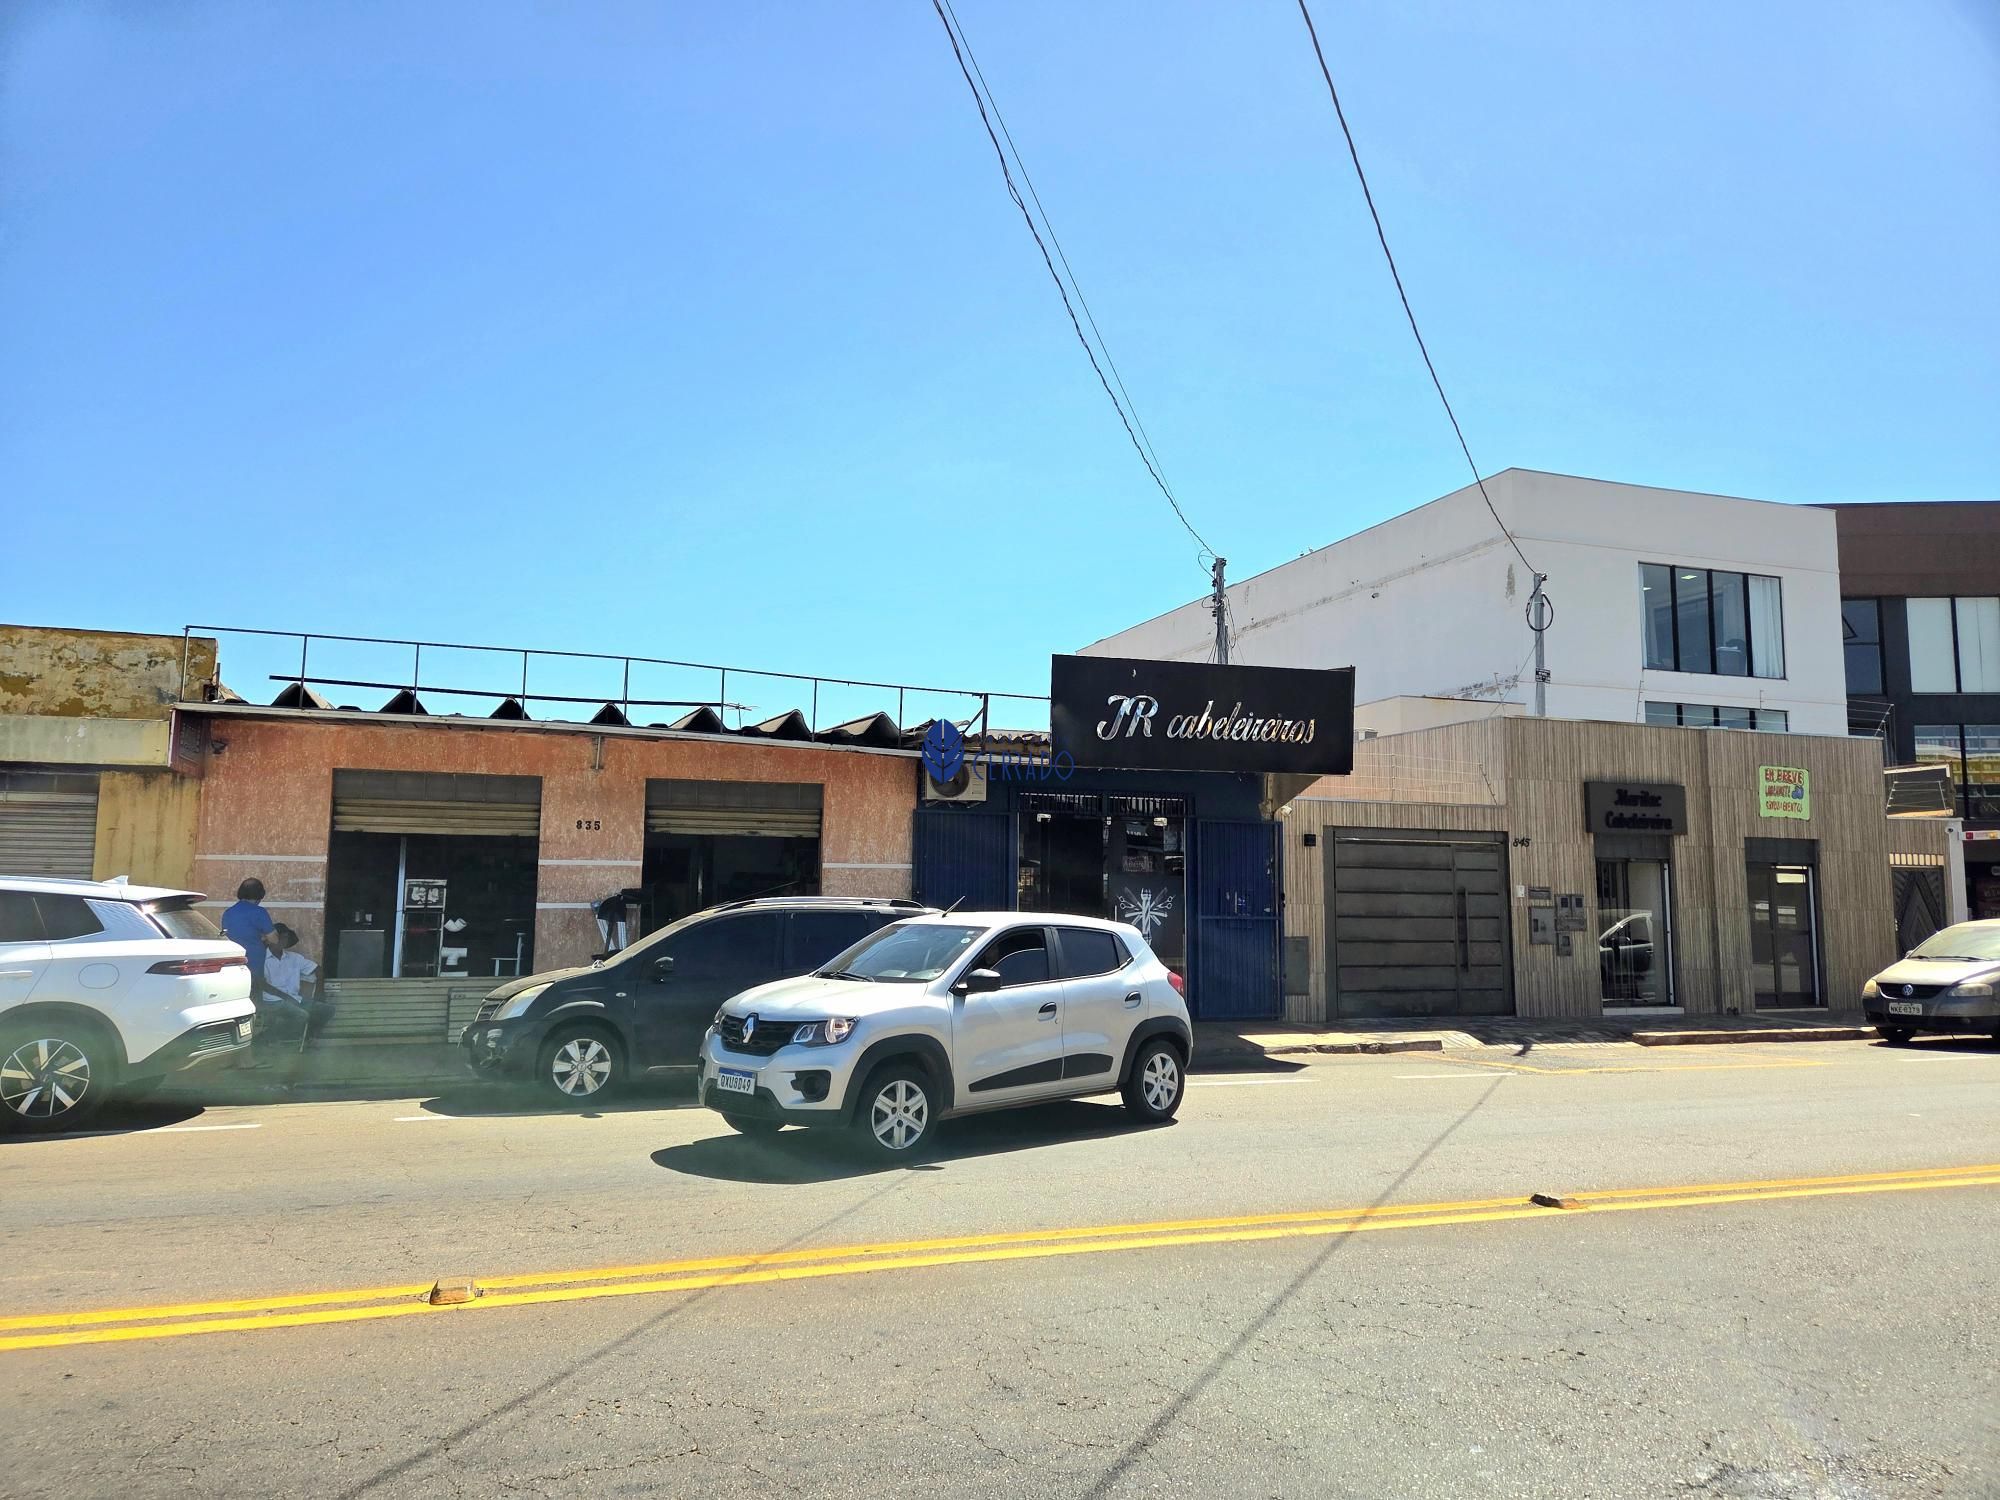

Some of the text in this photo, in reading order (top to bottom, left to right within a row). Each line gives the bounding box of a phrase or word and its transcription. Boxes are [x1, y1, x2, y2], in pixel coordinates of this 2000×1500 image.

[1096, 694, 1316, 746] JR cabeleireiros
[1776, 769, 1804, 786] BREVE
[576, 819, 601, 831] 835
[1513, 838, 1531, 848] 845
